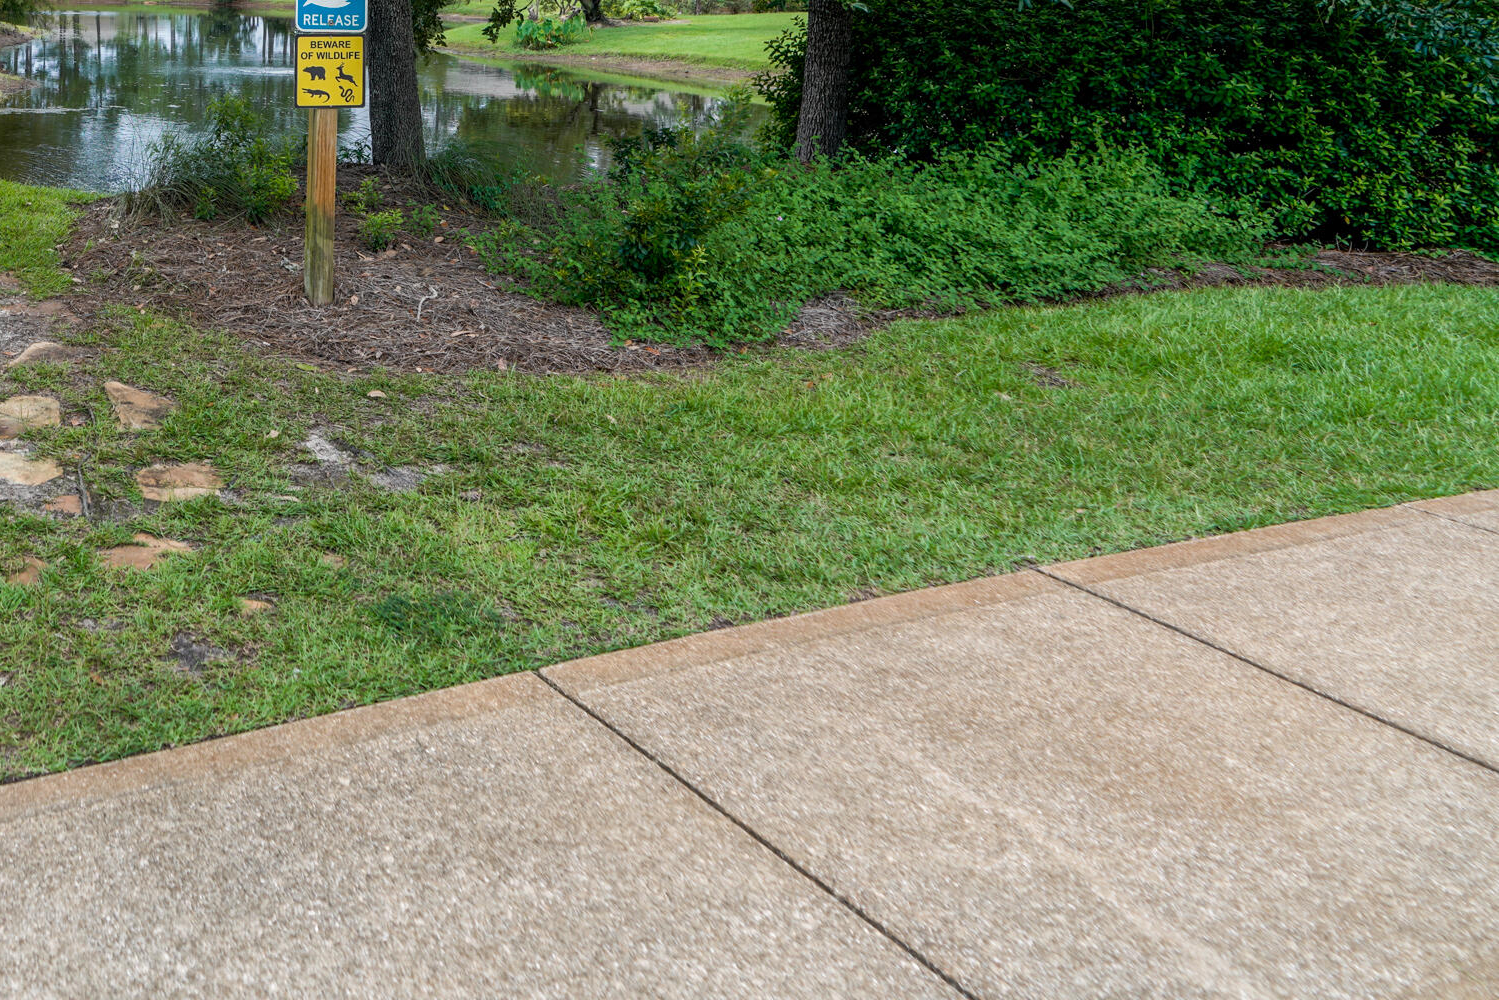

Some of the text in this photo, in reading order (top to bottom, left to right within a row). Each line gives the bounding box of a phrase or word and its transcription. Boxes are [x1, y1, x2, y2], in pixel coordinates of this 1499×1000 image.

[303, 14, 359, 26] RELEASE
[310, 40, 351, 49] BEWARE
[301, 51, 360, 60] OF WILDLIFE
